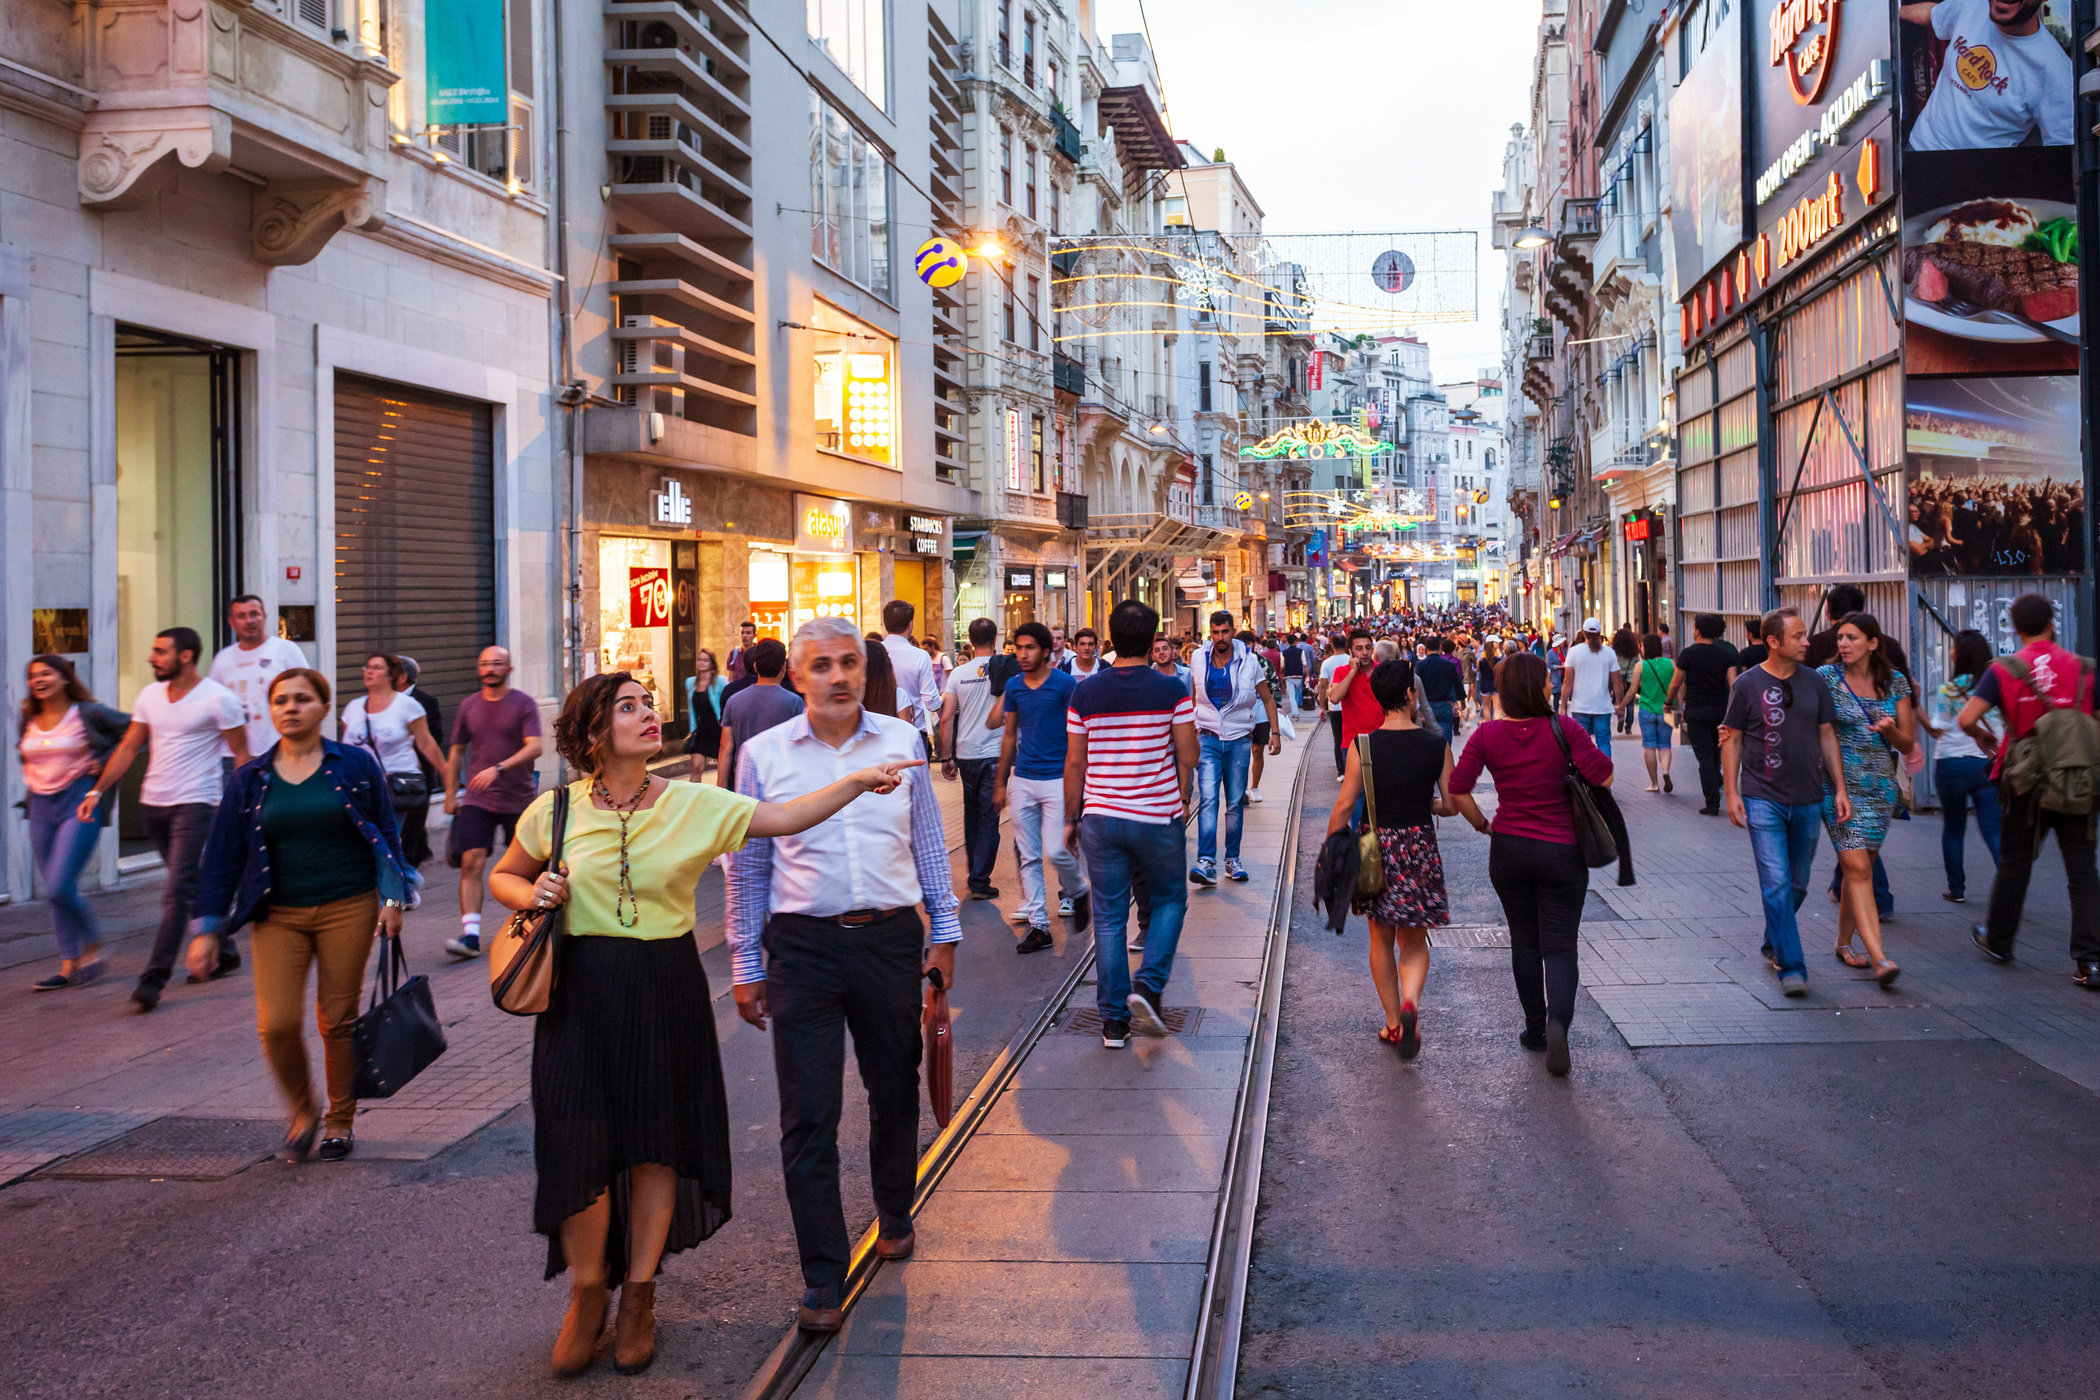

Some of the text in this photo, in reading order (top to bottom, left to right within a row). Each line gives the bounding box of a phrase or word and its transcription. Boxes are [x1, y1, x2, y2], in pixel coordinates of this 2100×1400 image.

[1797, 33, 1821, 76] CAFE
[1953, 36, 2009, 97] Hard Rock
[1961, 68, 1978, 85] CAFE
[1756, 157, 1784, 206] NOW
[1781, 129, 1814, 179] OPEN
[1777, 170, 1841, 270] 200mt
[909, 515, 943, 535] STARBUCKS
[916, 537, 938, 554] COFFEE
[629, 577, 641, 589] SON
